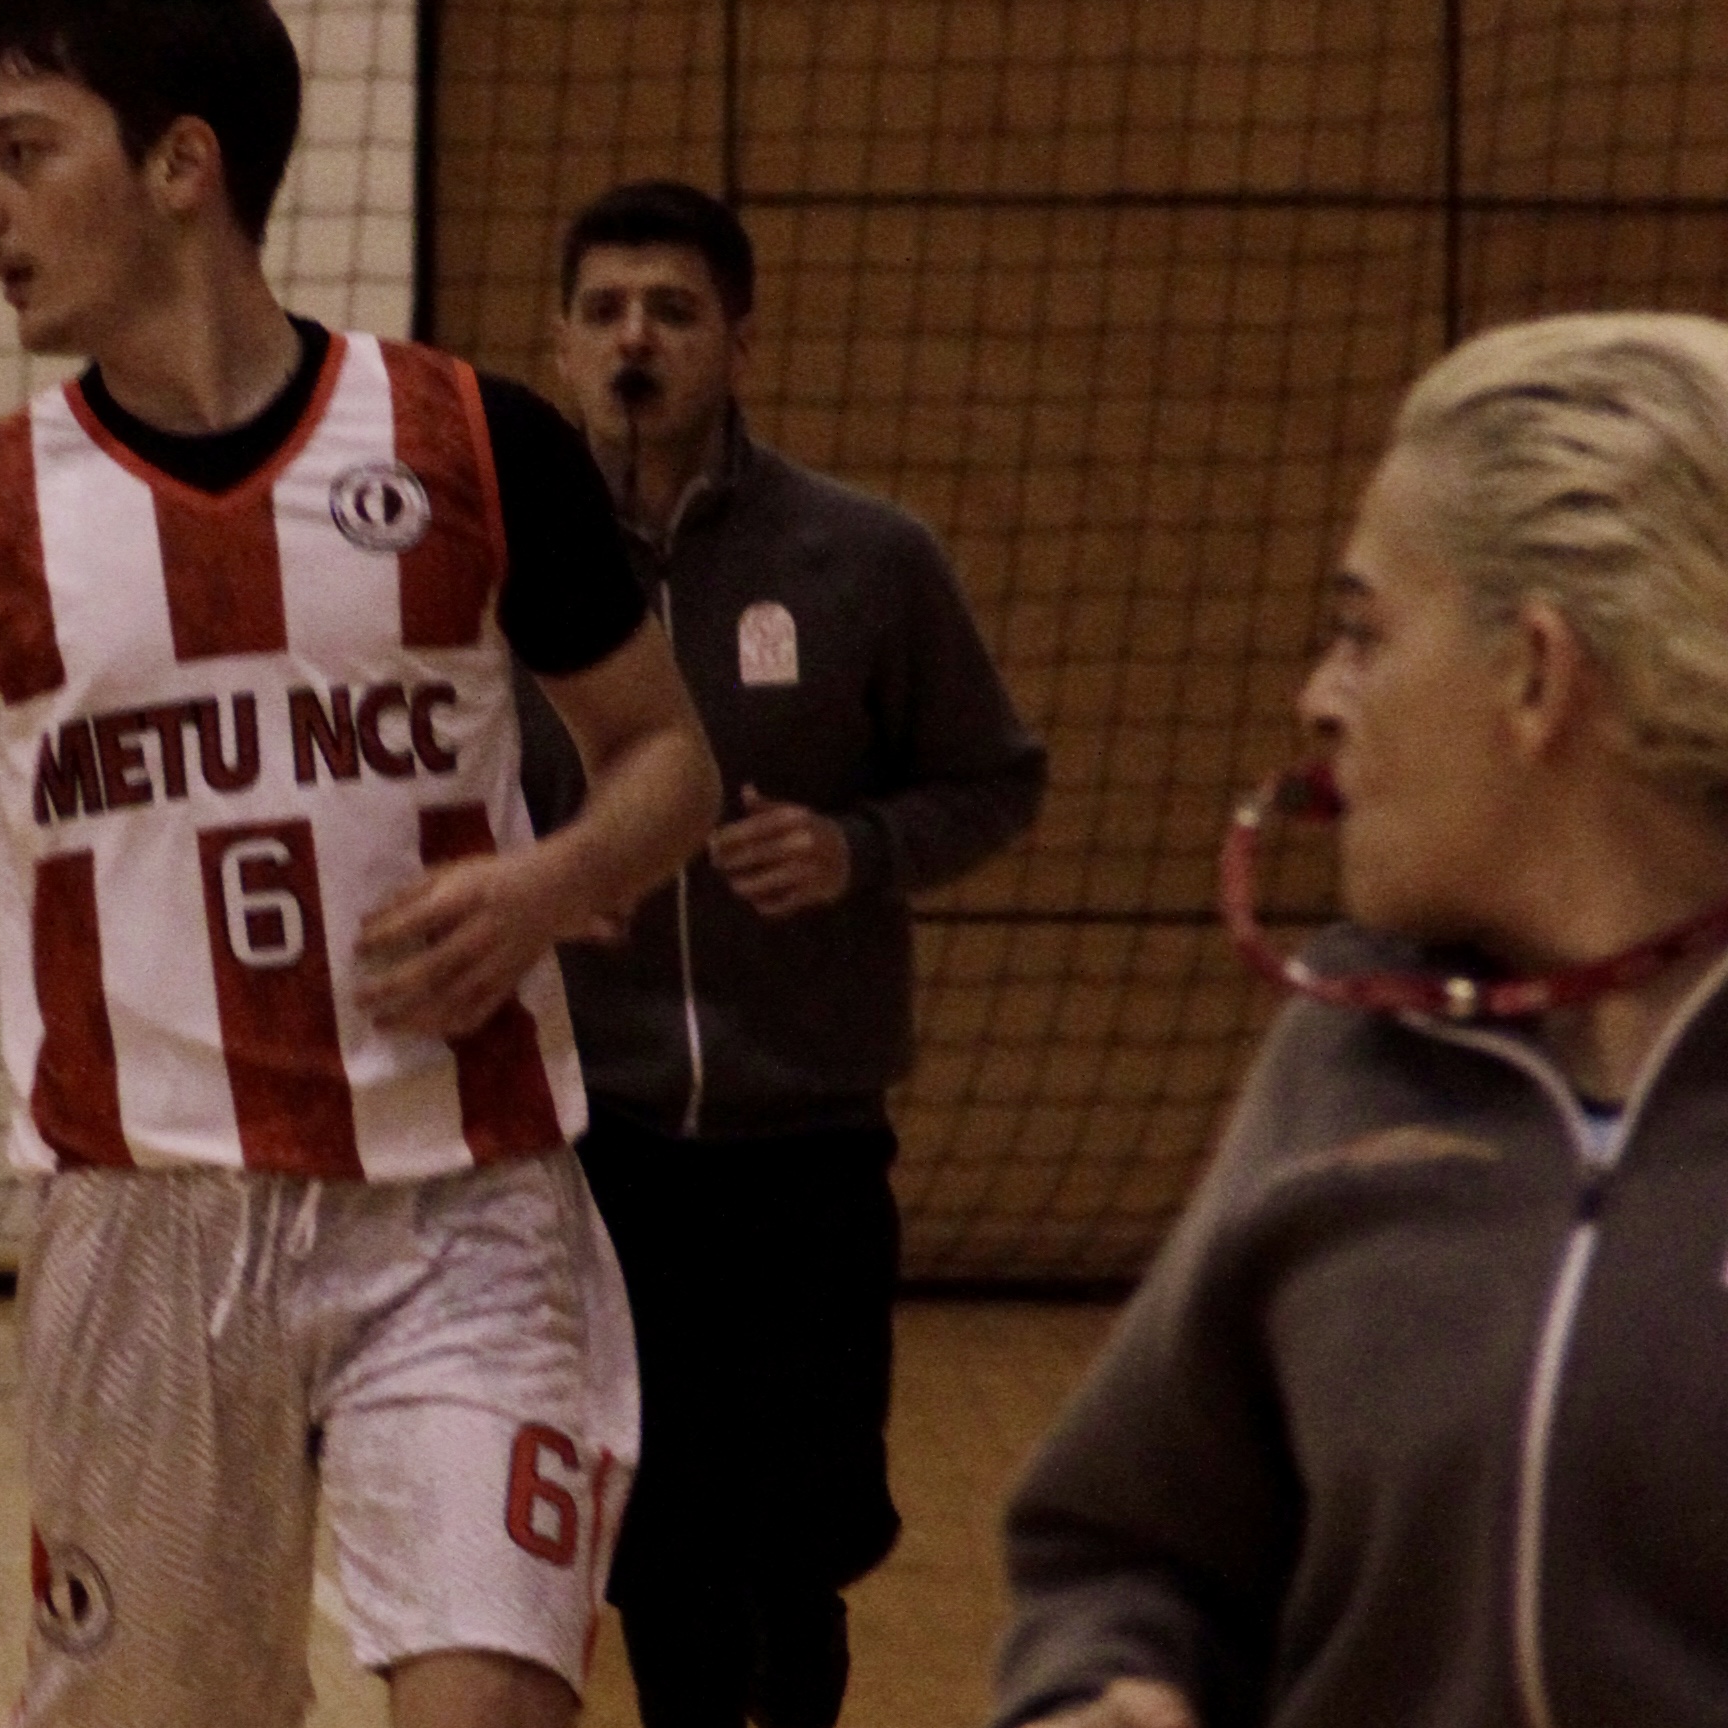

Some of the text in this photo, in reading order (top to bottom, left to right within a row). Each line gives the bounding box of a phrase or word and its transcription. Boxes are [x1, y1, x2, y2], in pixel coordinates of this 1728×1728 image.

[34, 680, 457, 824] METU NCC
[221, 838, 304, 969] 6
[506, 1422, 579, 1569] 6
